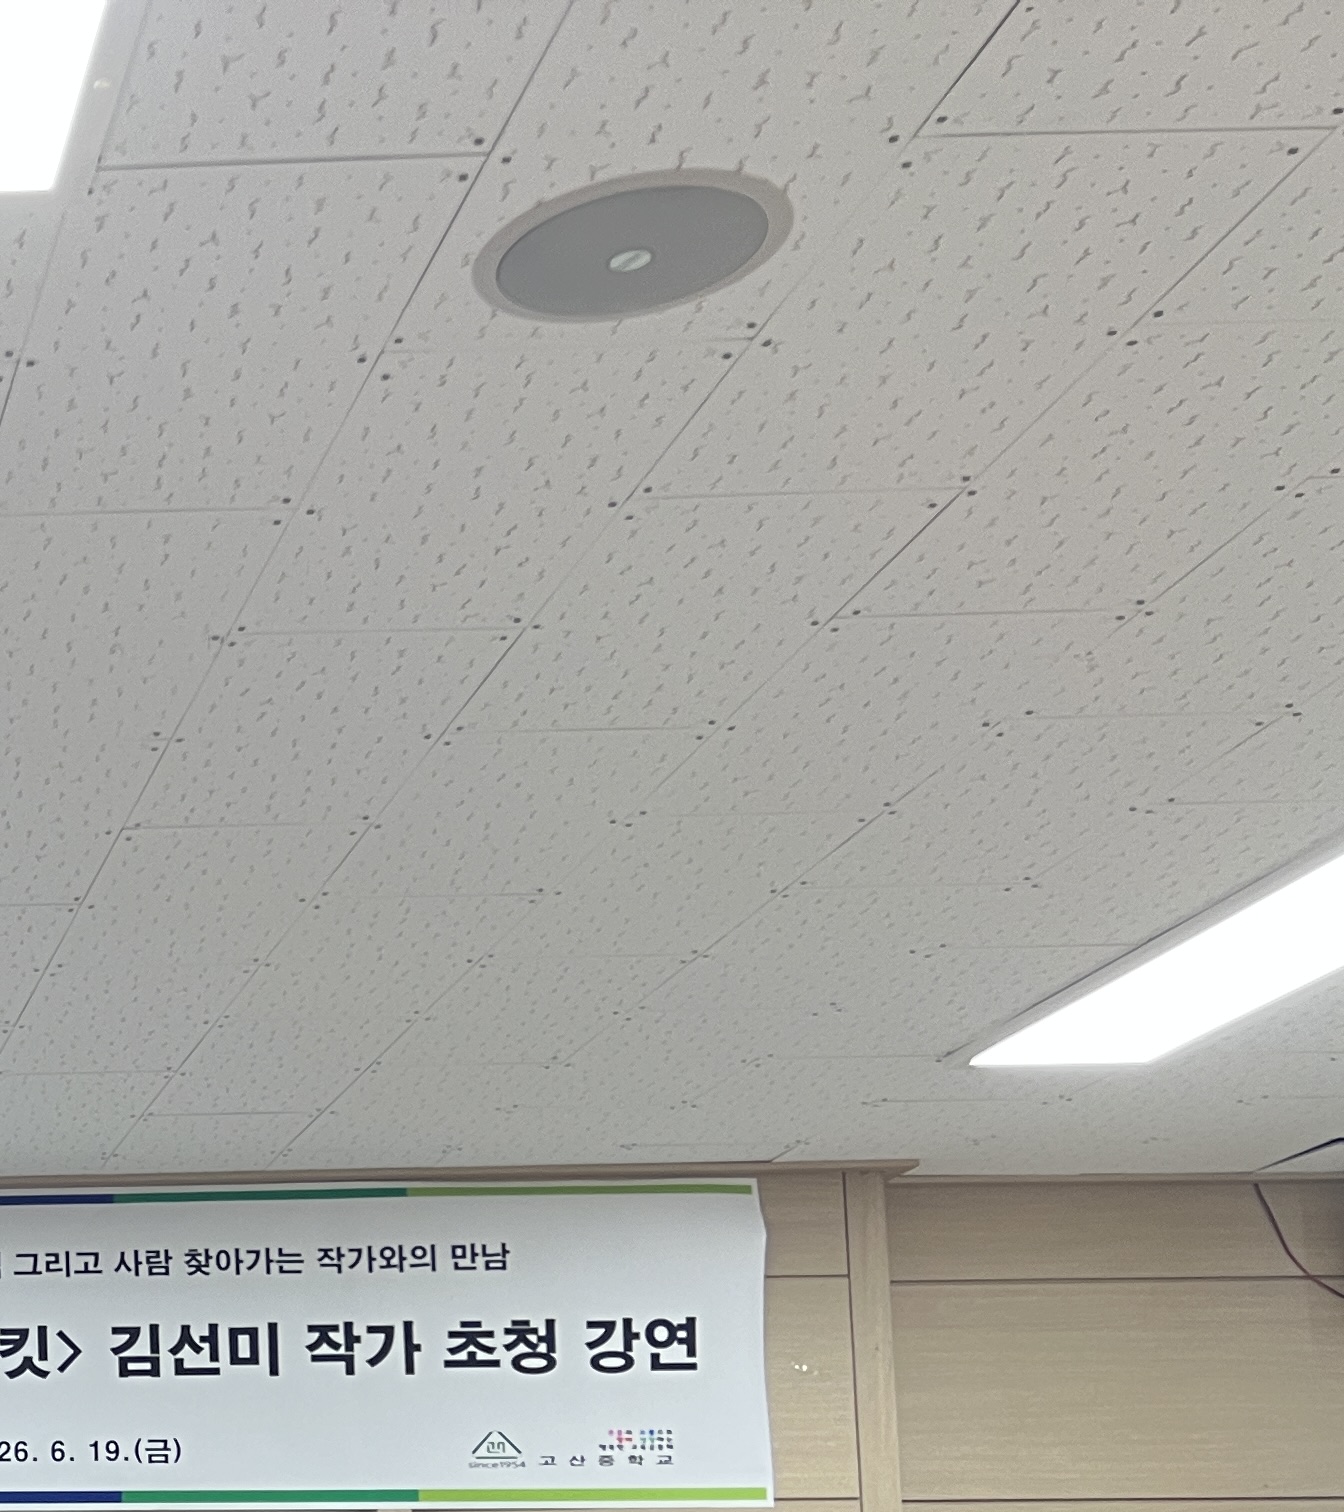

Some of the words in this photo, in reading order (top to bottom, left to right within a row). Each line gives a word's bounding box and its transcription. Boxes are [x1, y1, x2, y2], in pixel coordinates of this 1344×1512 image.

[13, 1250, 104, 1278] 그리고
[113, 1248, 174, 1277] 사람
[183, 1246, 305, 1277] 찾아가는
[316, 1243, 437, 1275] 작가와의
[450, 1242, 511, 1272] 만남
[109, 1321, 280, 1379] 김선미
[304, 1320, 422, 1376] 작가
[443, 1318, 558, 1375] 초청
[584, 1316, 698, 1374] 강연
[50, 1439, 75, 1463] 6.
